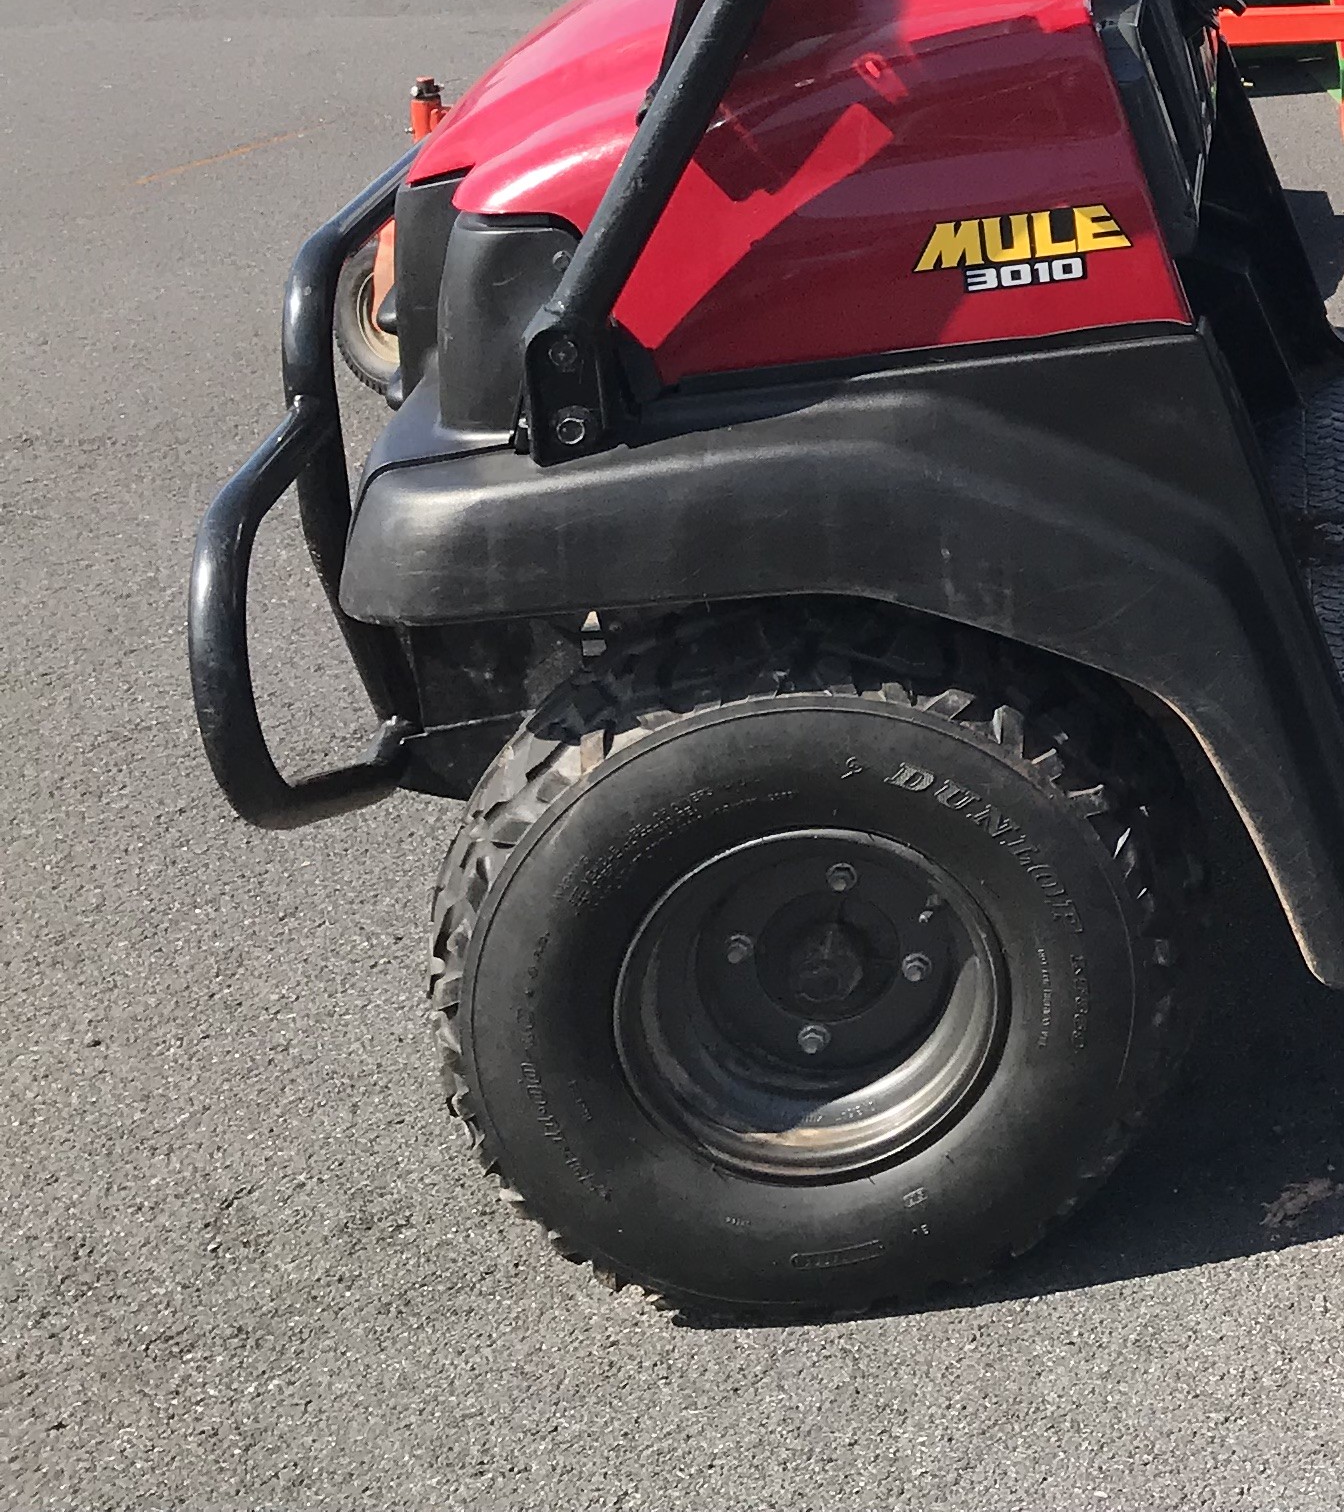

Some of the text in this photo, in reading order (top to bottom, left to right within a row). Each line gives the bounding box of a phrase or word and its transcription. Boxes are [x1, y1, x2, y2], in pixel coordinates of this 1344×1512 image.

[914, 204, 1132, 272] MULE
[966, 257, 1084, 292] 3010
[883, 761, 1084, 934] DUNLOP
